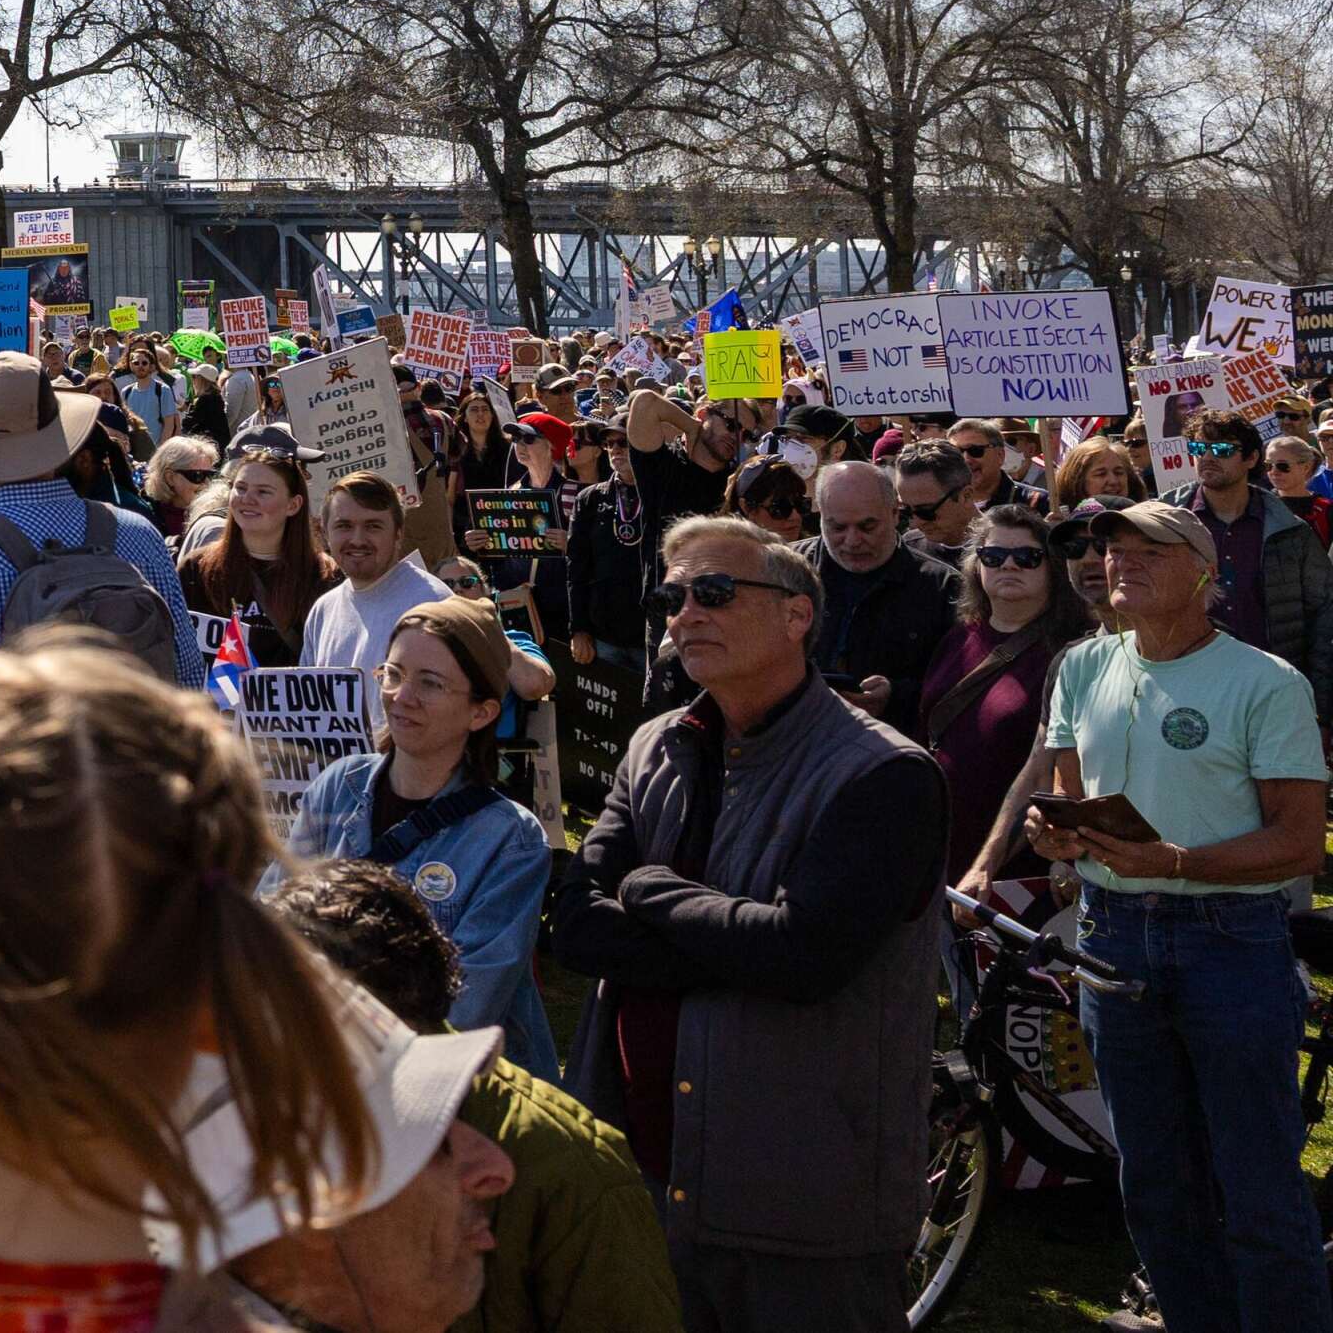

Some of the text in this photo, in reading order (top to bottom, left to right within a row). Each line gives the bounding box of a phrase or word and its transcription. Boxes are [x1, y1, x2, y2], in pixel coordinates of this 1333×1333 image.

[17, 210, 71, 223] KEEP HOPE
[40, 233, 71, 245] JESSE
[4, 244, 86, 257] MERCHANT DEATH
[222, 297, 264, 313] REVOKE
[1213, 283, 1278, 311] POWER
[49, 304, 89, 314] PROGRAMS
[971, 297, 1083, 321] INVOKE
[224, 313, 267, 331] THE ICE
[413, 311, 471, 335] REVOKE
[826, 308, 942, 350] DEMOCRAC
[1204, 311, 1266, 353] WE
[228, 332, 269, 348] PERMIT!
[410, 325, 439, 351] THE
[440, 331, 467, 356] ICE
[469, 332, 510, 344] REVOKE
[945, 327, 1020, 349] ARTICLE
[1023, 327, 1039, 346] II
[1089, 322, 1108, 345] 4
[405, 346, 464, 373] PERMIT!
[470, 342, 512, 357] THE ICE
[872, 346, 914, 368] NOT
[328, 359, 349, 370] NO
[947, 353, 1114, 375] US CONSTITUTION
[1001, 377, 1091, 403] NOW!!!
[1148, 373, 1215, 397] NO KING
[1254, 366, 1286, 398] ICE
[308, 378, 376, 409] history!
[336, 400, 355, 412] in
[318, 409, 378, 438] crowd
[316, 423, 385, 451] biggest
[323, 436, 387, 463] got the
[1162, 455, 1184, 471] NO
[476, 499, 550, 513] democracy
[479, 514, 527, 528] dies in
[242, 674, 359, 713] WE DON'T
[576, 674, 618, 703] HANDS
[586, 698, 614, 720] OFF!
[246, 716, 362, 734] WANT AN
[579, 760, 595, 778] NO
